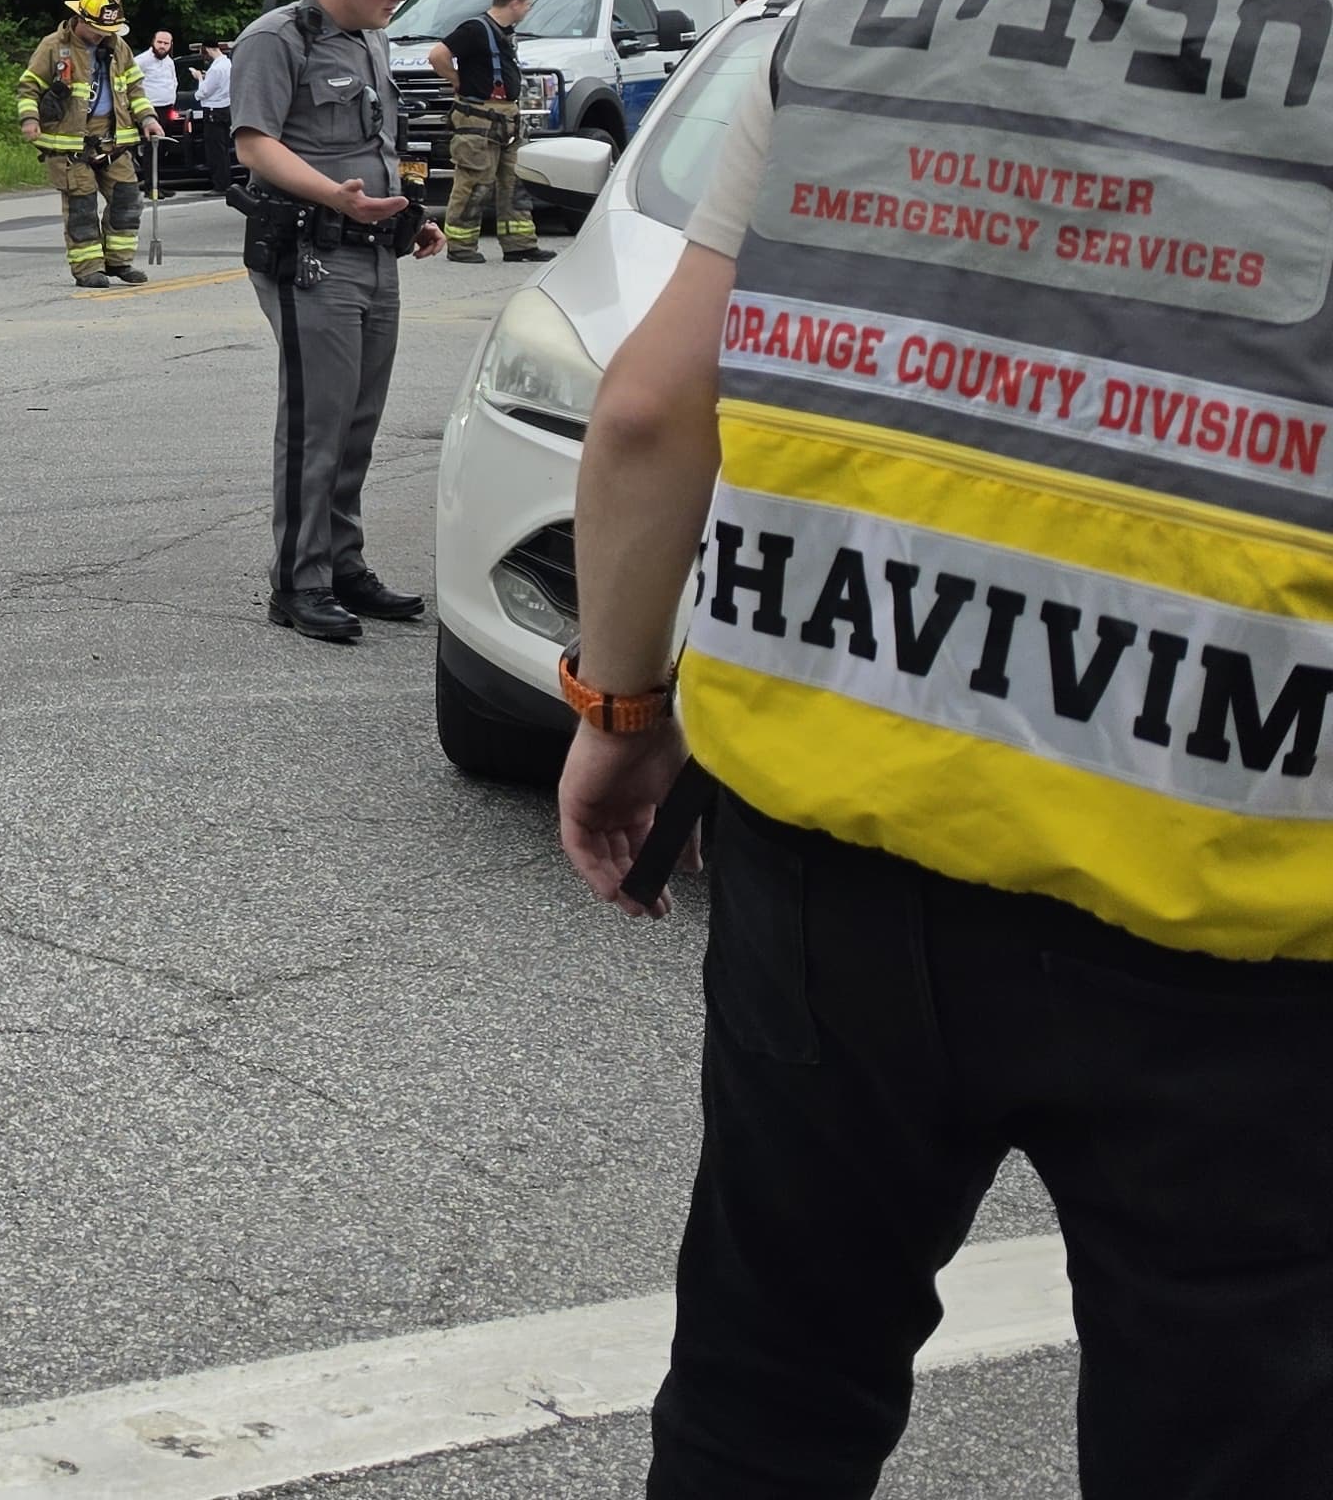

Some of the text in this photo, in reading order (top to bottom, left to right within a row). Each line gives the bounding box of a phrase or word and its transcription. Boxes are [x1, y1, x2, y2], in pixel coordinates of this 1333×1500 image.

[790, 183, 1266, 288] EMERGENCY SERVICES
[908, 147, 1155, 215] VOLUNTEER
[725, 304, 1328, 477] ORANGE COUNTY DIVISION
[694, 520, 1333, 777] HAVIVIM
